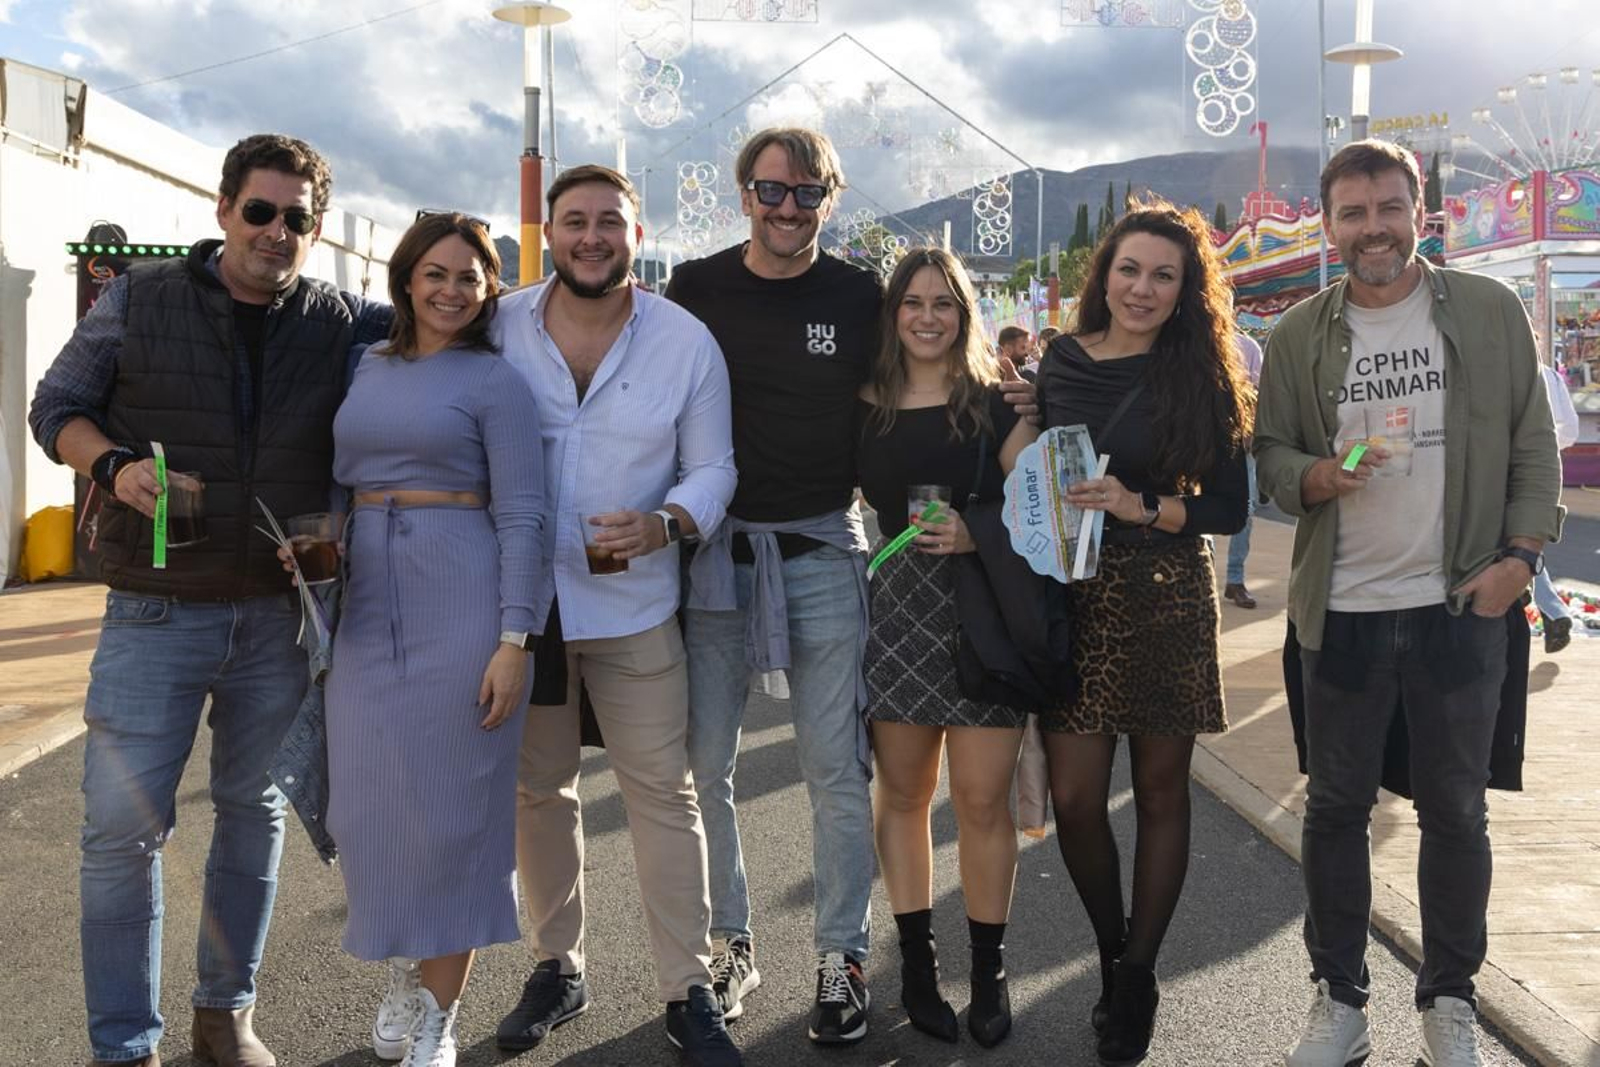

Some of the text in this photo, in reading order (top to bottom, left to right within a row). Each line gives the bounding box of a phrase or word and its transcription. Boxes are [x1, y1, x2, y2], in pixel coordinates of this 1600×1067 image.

[807, 323, 835, 339] HU
[807, 339, 837, 355] GO
[1356, 347, 1430, 376] CPHN
[1337, 369, 1447, 405] DENMAR
[1025, 467, 1042, 527] friomar
